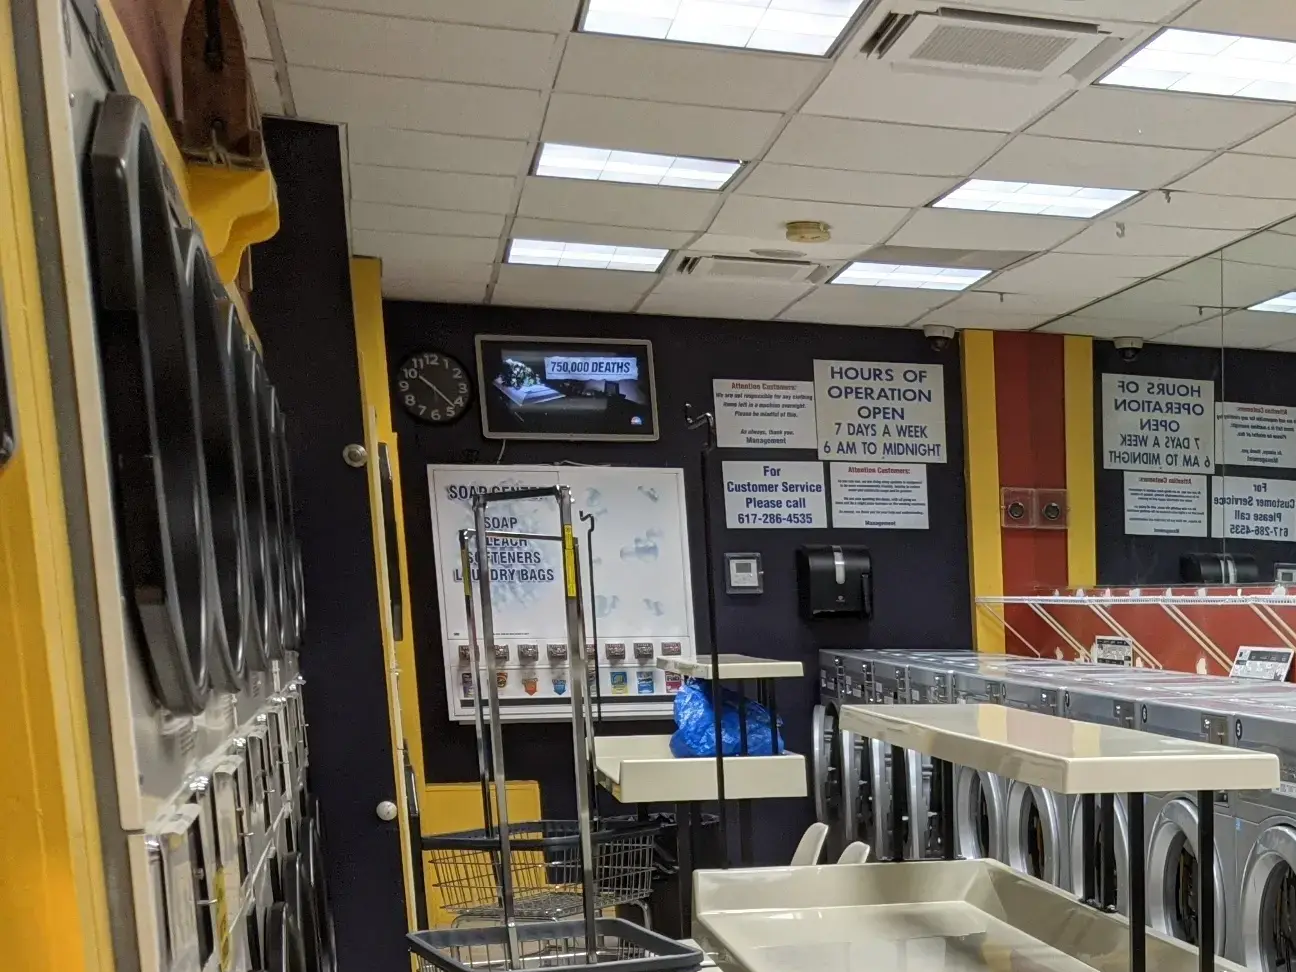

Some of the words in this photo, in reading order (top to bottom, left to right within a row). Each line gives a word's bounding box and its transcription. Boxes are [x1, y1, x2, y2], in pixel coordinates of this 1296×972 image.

[412, 358, 424, 369] 11
[424, 354, 439, 365] 12
[444, 359, 448, 369] 1
[551, 361, 589, 374] 750,000
[592, 362, 631, 374] DEATHS
[403, 368, 418, 379] 10
[453, 368, 462, 379] 2
[831, 366, 894, 381] HOURS
[903, 370, 927, 383] OF
[399, 381, 409, 392] 9
[458, 383, 468, 394] 3
[732, 382, 760, 390] Attention
[762, 383, 797, 391] Customers:
[828, 386, 932, 403] OPERATION
[405, 395, 416, 406] 8
[454, 396, 464, 407] 4
[418, 405, 427, 416] 7
[431, 409, 441, 420] 6
[446, 407, 455, 417] 5
[858, 406, 905, 420] OPEN
[835, 423, 842, 436] 7
[847, 423, 877, 436] DAYS
[882, 424, 892, 437] A
[896, 424, 928, 438] WEEK
[746, 437, 787, 445] Management
[824, 441, 831, 454] 6
[837, 441, 857, 454] AM
[862, 442, 877, 455] TO
[883, 443, 941, 457] MIDNIGHT
[763, 466, 781, 477] For
[848, 466, 876, 474] Attention
[877, 467, 911, 475] Customers:
[727, 481, 779, 493] Customer
[782, 482, 822, 493] Service
[746, 497, 784, 509] Please
[786, 498, 806, 509] call
[485, 517, 518, 529] SOAP
[738, 513, 813, 524] 617-286-4535
[486, 538, 528, 547] LEACH
[456, 569, 516, 581] LUDRY
[521, 569, 554, 581] BAGS
